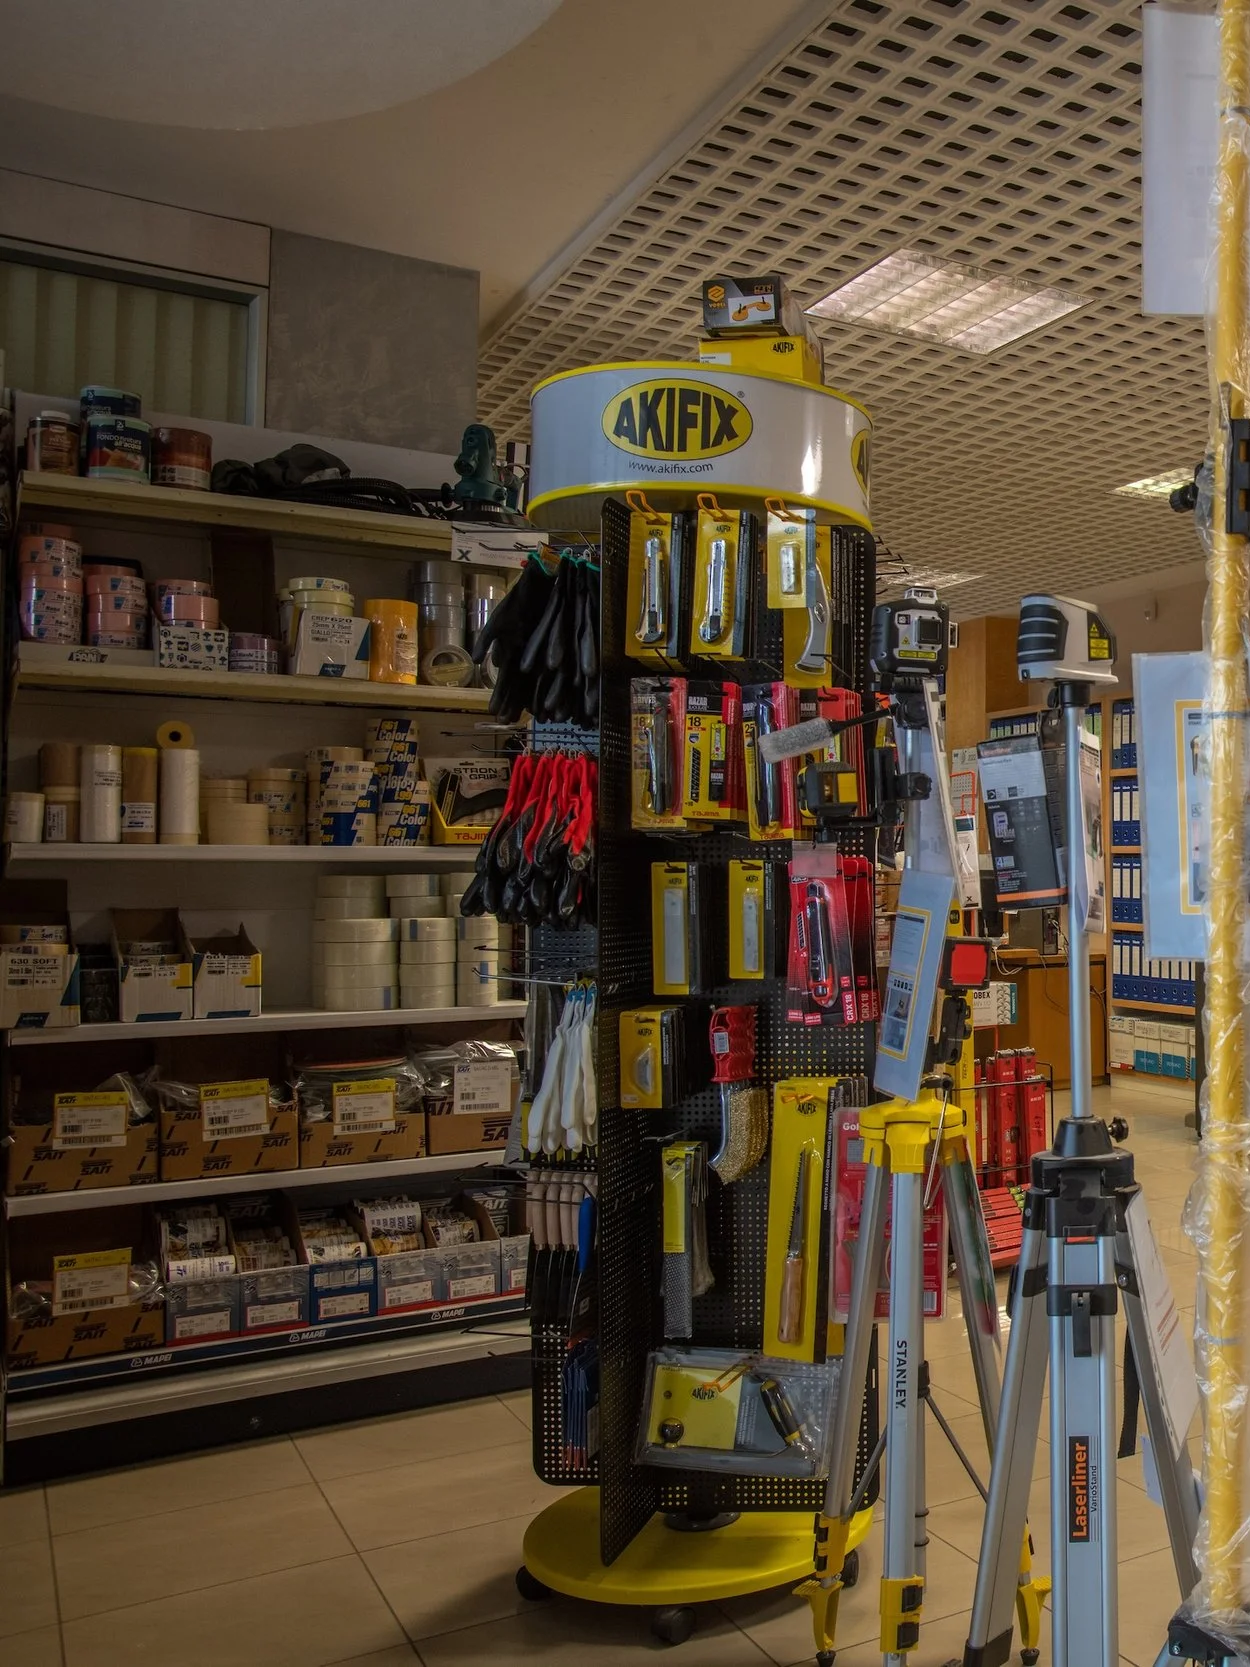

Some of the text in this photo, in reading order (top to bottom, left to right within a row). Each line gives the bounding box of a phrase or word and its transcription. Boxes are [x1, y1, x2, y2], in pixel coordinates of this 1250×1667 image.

[772, 341, 795, 353] AKIFIX
[613, 387, 739, 453] AKIFIX
[629, 460, 713, 474] www.akifix.com
[688, 716, 701, 727] 18
[379, 731, 407, 741] Color
[390, 752, 416, 763] Color
[400, 814, 426, 825] Color
[797, 1102, 816, 1115] AKIFIX
[442, 1308, 465, 1319] MAPEI
[301, 1329, 327, 1340] MAPEI
[144, 1353, 173, 1365] MAPEI
[1072, 1443, 1089, 1538] Laserliner
[1090, 1465, 1098, 1513] VarioStand
